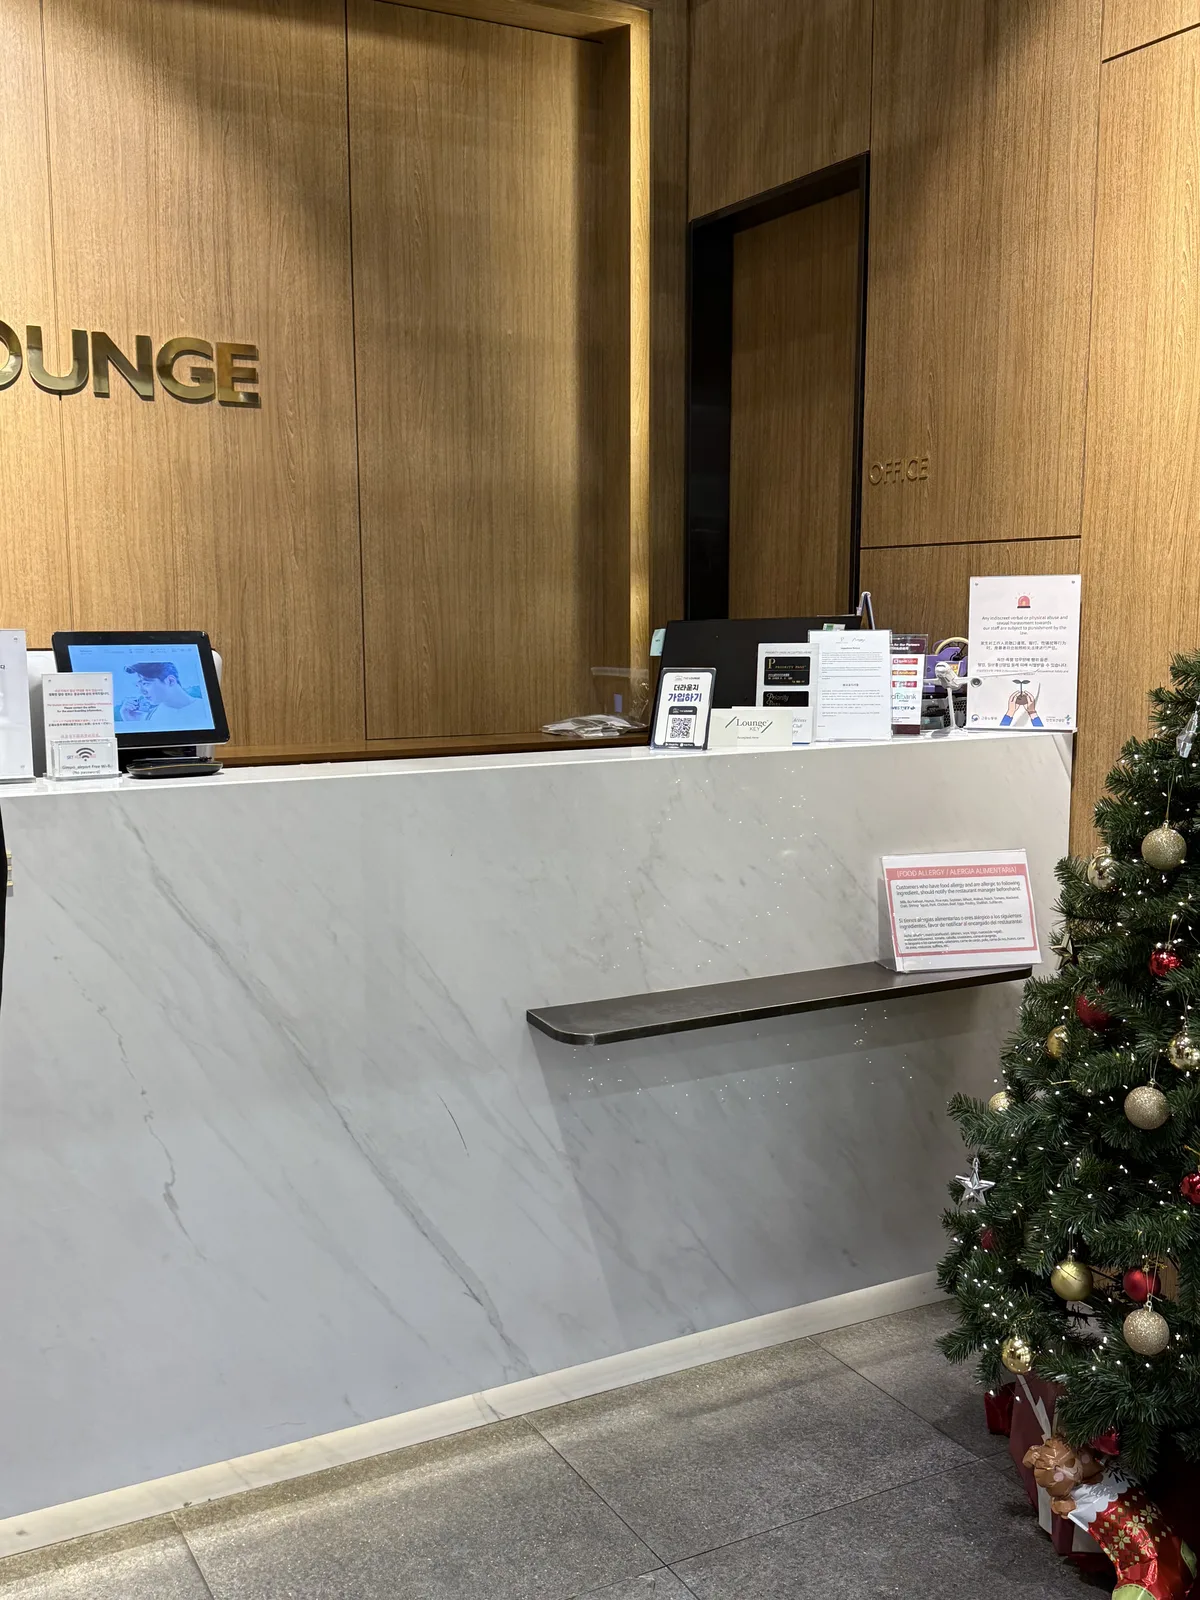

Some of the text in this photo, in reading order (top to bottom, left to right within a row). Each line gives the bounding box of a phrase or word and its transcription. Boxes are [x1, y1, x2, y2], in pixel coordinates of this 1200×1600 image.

[869, 458, 929, 485] OFFICE
[767, 658, 776, 669] P
[673, 683, 699, 691] 더라운지
[668, 692, 702, 702] 가입하기
[766, 693, 789, 702] Priority
[736, 718, 767, 728] Lounge
[918, 868, 944, 876] ALLERGY
[950, 867, 975, 875] ALERGIA
